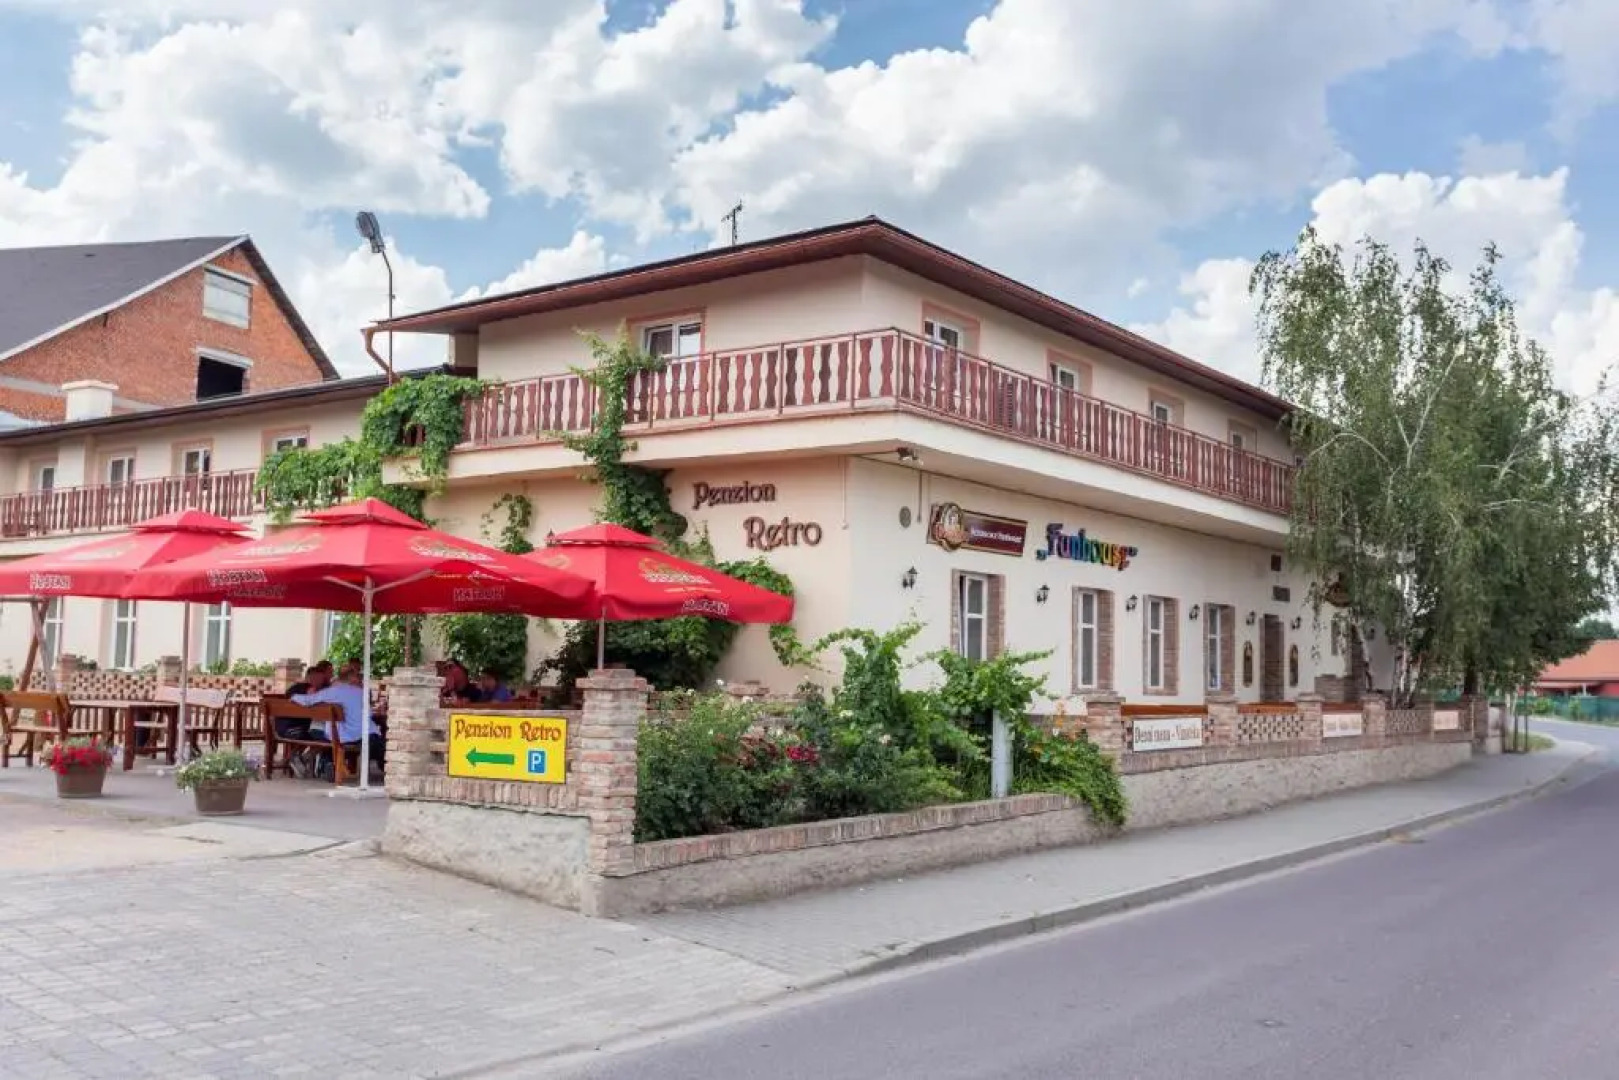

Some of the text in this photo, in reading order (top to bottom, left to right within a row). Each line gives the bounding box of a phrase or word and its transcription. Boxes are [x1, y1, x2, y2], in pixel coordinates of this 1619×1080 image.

[692, 481, 776, 511] Penzion
[743, 516, 822, 551] Retro
[454, 719, 562, 741] Penzion Retro
[531, 752, 542, 771] P
